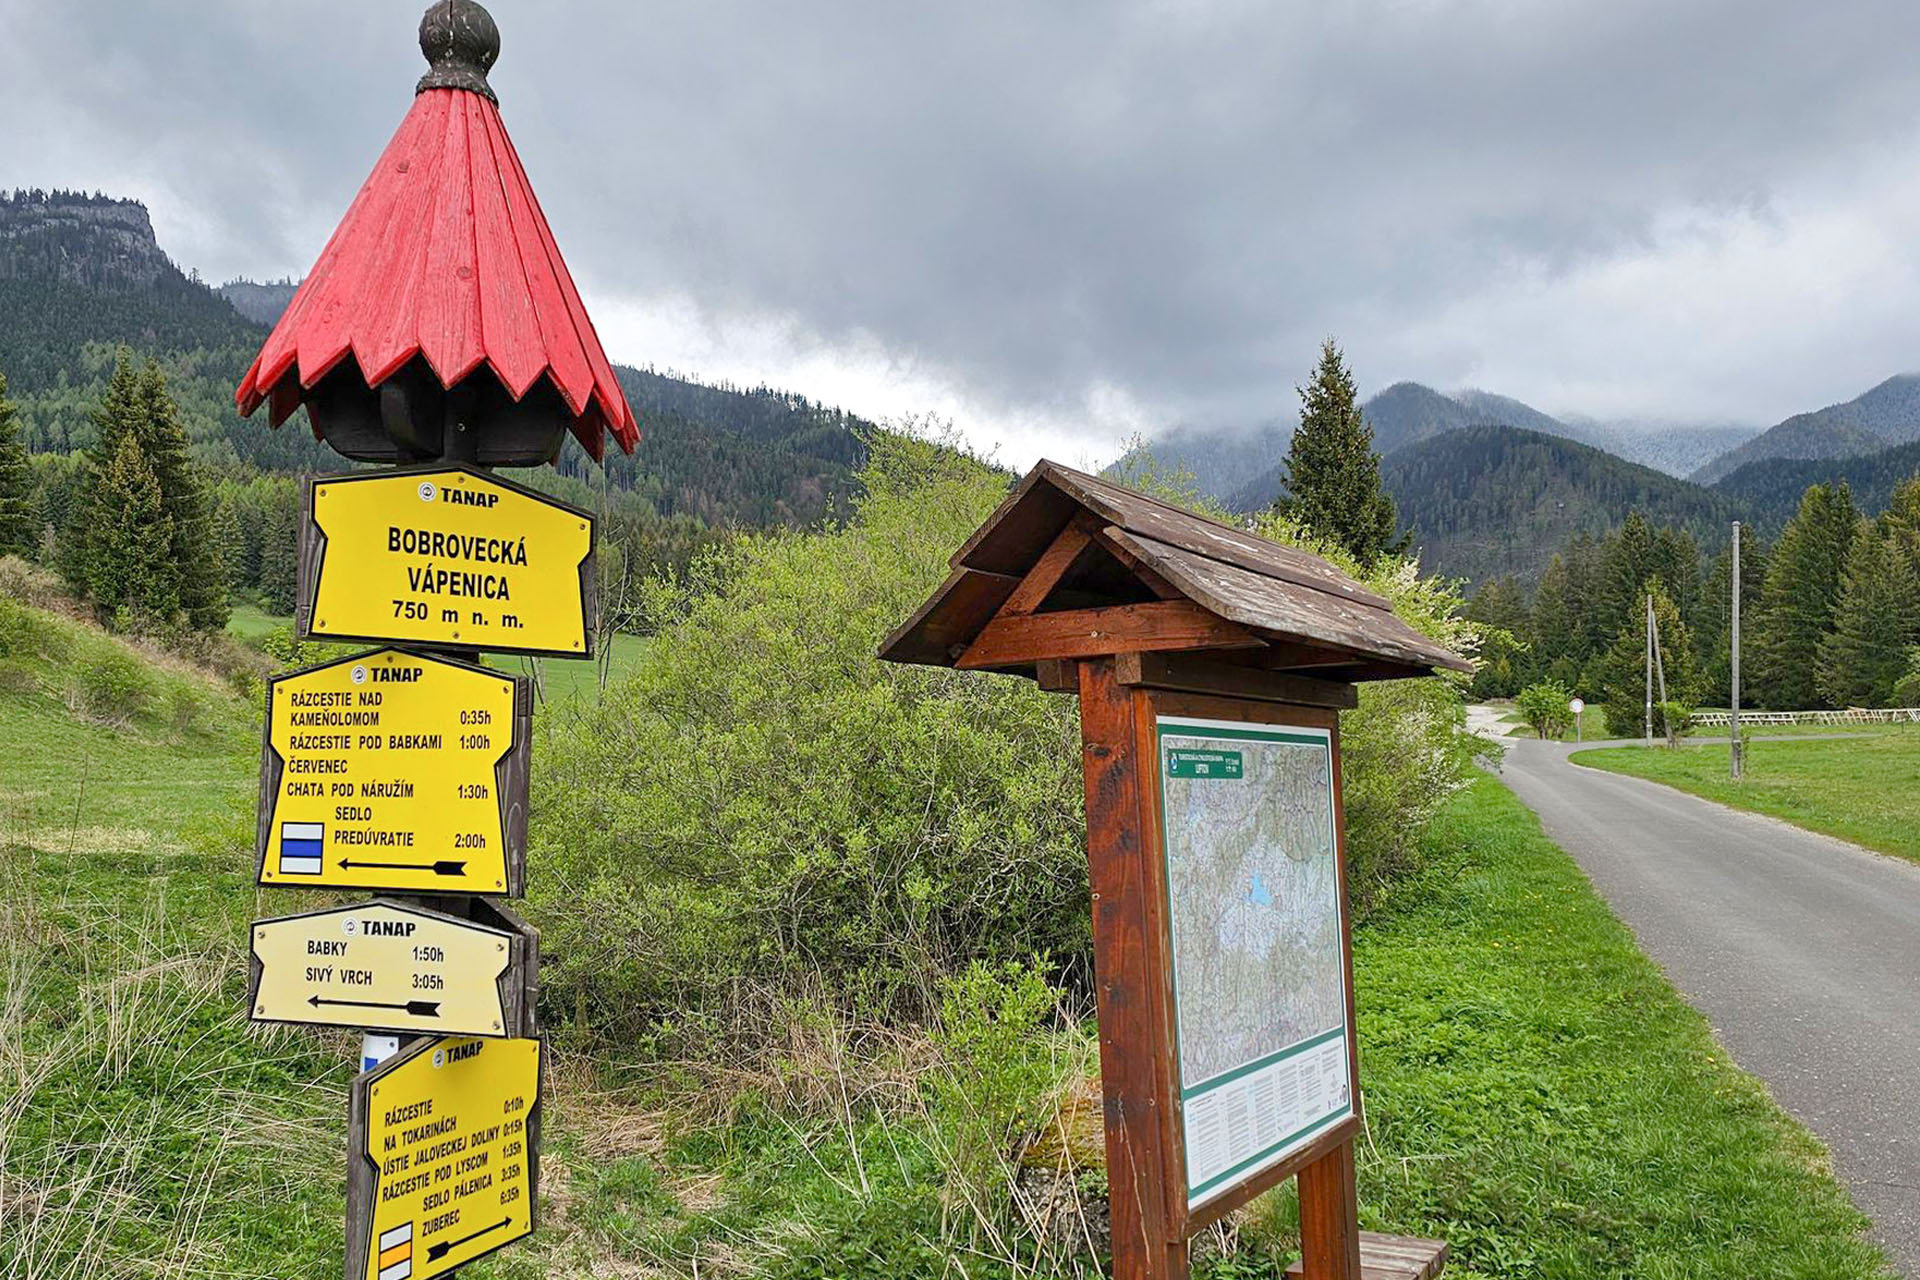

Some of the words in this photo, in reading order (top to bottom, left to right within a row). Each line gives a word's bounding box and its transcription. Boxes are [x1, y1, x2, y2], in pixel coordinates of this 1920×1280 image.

[441, 488, 498, 508] TANAP
[388, 526, 527, 566] BOBROVECKÁ
[408, 563, 509, 600] VÁPENICA
[393, 600, 428, 620] 750
[442, 608, 458, 622] m
[472, 611, 488, 626] n.
[502, 614, 524, 628] m.
[371, 668, 423, 683] TANAP
[291, 687, 351, 707] RÁZCESTIE
[359, 692, 382, 706] NAD
[290, 709, 379, 726] KAMEŇOLOMOM
[460, 711, 491, 725] 0:35h
[290, 732, 350, 749] RÁZCESTIE
[359, 736, 382, 749] POD
[389, 735, 442, 749] BABKAMI
[459, 735, 490, 749] 1:00h
[289, 756, 347, 773] ČERVENEC
[287, 783, 324, 797] CHATA
[332, 783, 353, 797] POD
[361, 780, 413, 798] NÁRUŽÍM
[458, 785, 488, 799] 1:30h
[335, 807, 371, 821] SEDLO
[334, 826, 413, 846] PREDÚVRATIE
[455, 834, 485, 848] 2:00h
[362, 921, 416, 937] TANAP
[308, 940, 347, 956] BABKY
[412, 946, 444, 962] 1:50h
[306, 965, 333, 984] SIVÝ
[341, 969, 372, 985] VRCH
[412, 974, 443, 990] 3:05h
[447, 1041, 483, 1064] TANAP
[385, 1099, 433, 1127] RÁZCESTIE
[384, 1135, 396, 1152] NA
[402, 1116, 457, 1146] TOKARINÁCH
[504, 1099, 524, 1114] 0:10h
[383, 1155, 409, 1176] ÚSTIE
[414, 1139, 467, 1169] JALOVECKEJ
[471, 1127, 500, 1148] DOLINY
[503, 1120, 523, 1137] 0:15h
[382, 1173, 430, 1202] RÁZCESTIE
[434, 1164, 452, 1183] POD
[456, 1152, 488, 1175] LYSCOM
[502, 1142, 521, 1159] 1:35h
[423, 1192, 449, 1212] SEDLO
[454, 1174, 492, 1202] PÁLENICA
[501, 1164, 521, 1182] 3:35h
[422, 1209, 460, 1237] ZUBEREC
